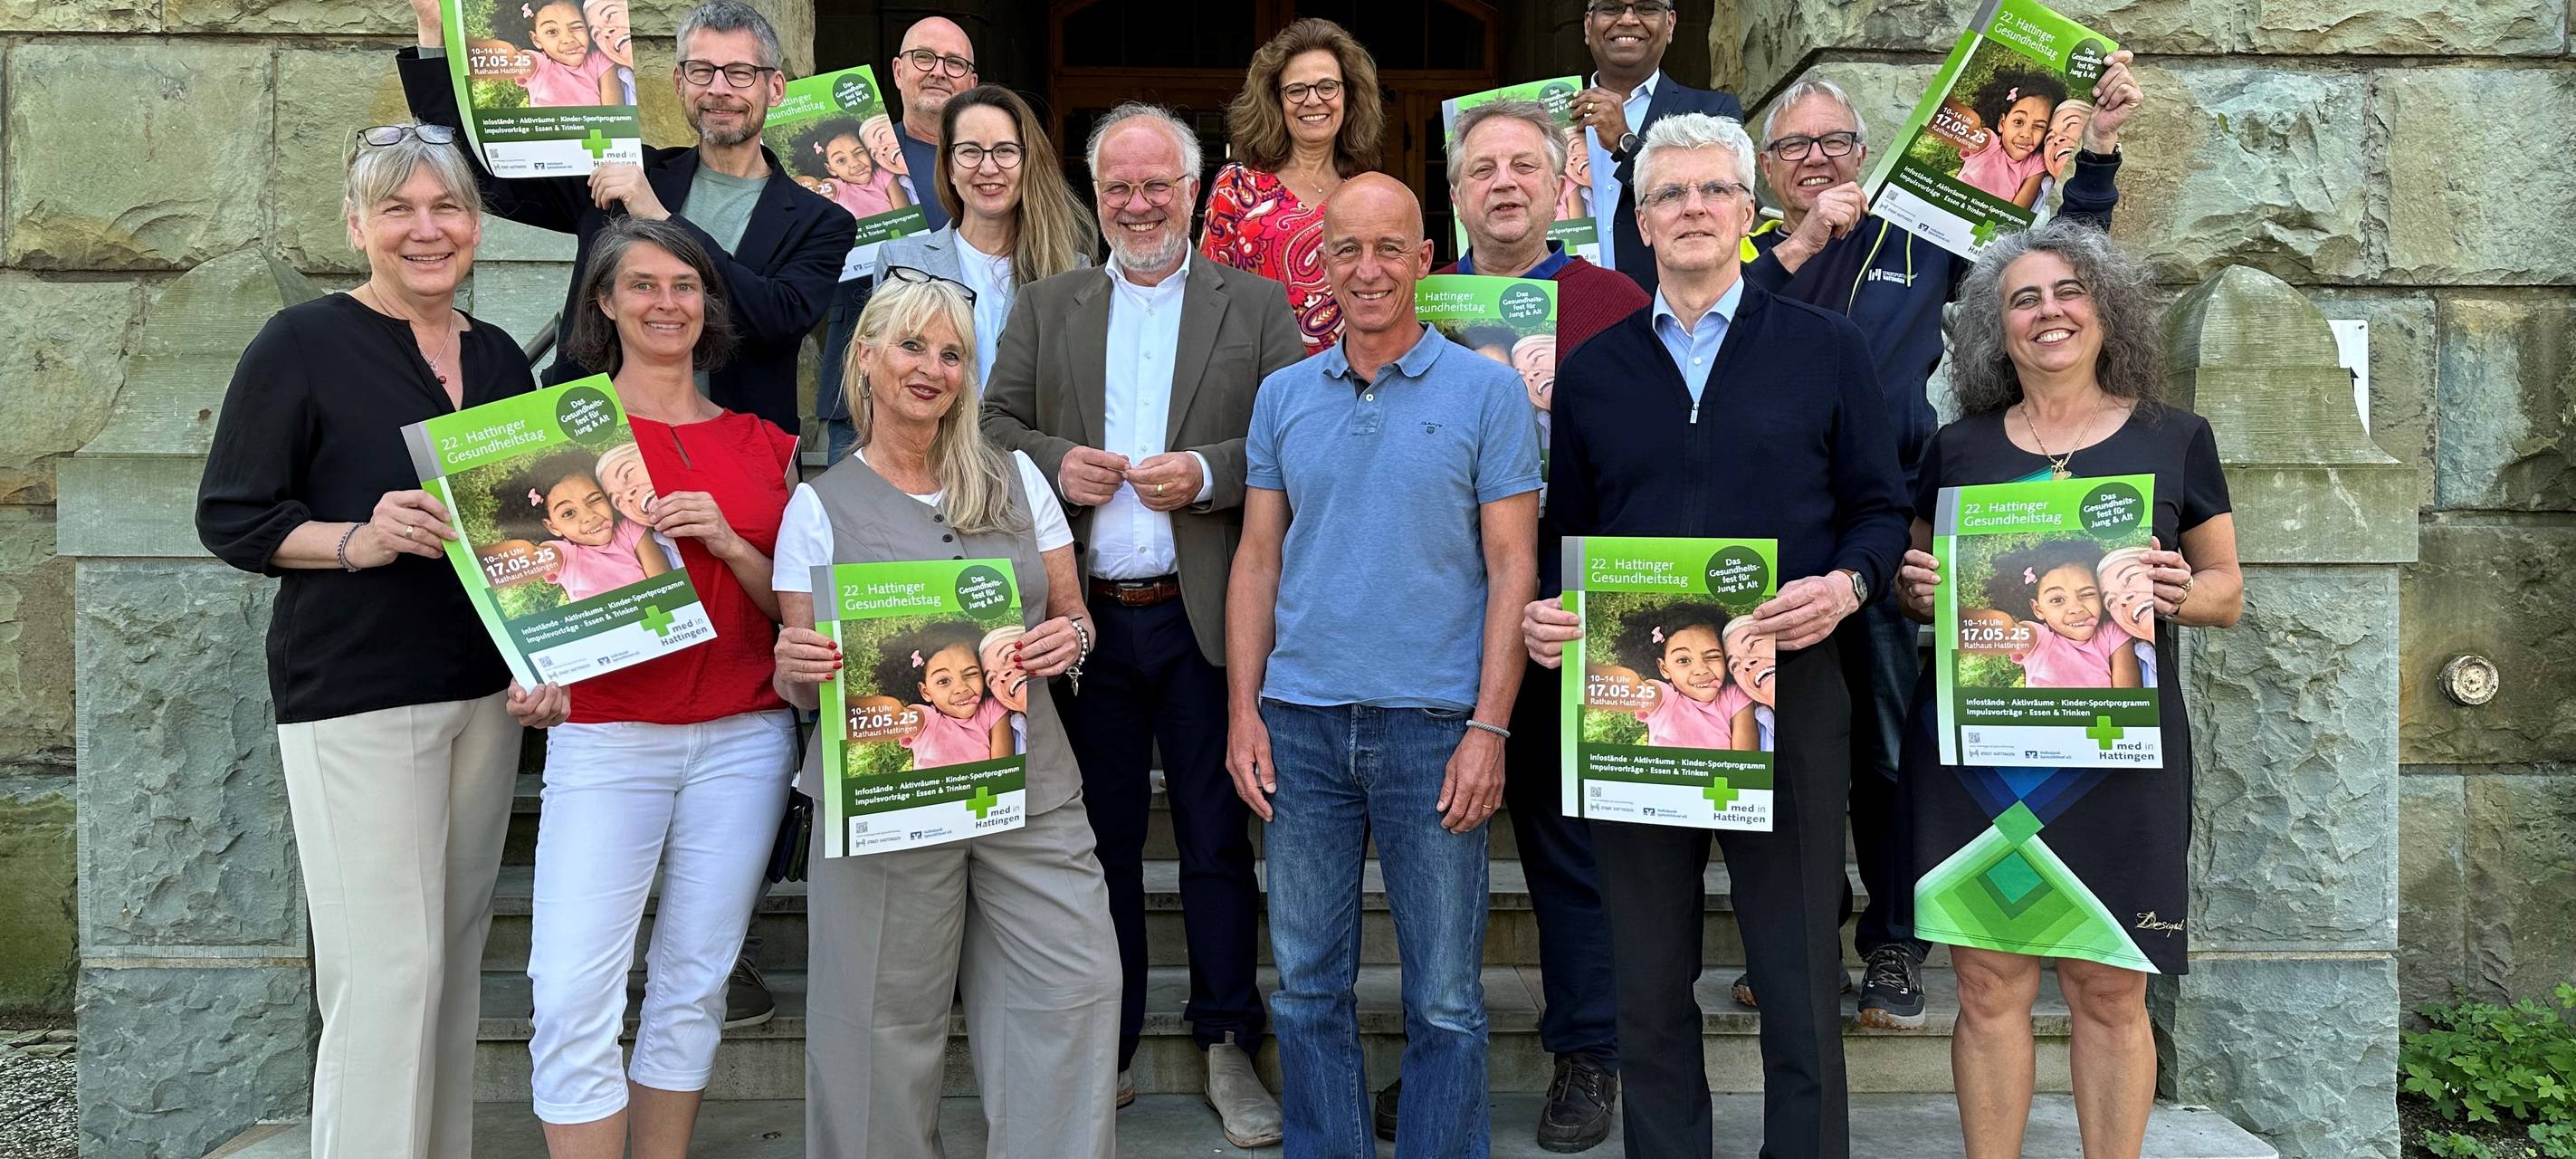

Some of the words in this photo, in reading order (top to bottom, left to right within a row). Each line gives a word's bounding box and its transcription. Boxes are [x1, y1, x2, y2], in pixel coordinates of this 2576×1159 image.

[1999, 10, 2014, 24] 22.
[2016, 17, 2056, 43] Hattinger
[1993, 22, 2059, 61] Gesundheitstag
[471, 55, 531, 68] 17.05.25
[766, 101, 825, 120] esundheitstag
[1961, 116, 1973, 125] Uhr
[1935, 113, 1988, 144] 17.05.25
[1931, 124, 1954, 139] Rathaus
[1953, 135, 1980, 150] Hattingen
[1899, 173, 1941, 197] Impulsvorträge
[1943, 195, 1960, 206] Essen
[1966, 205, 1986, 217] Trinken
[1903, 166, 1933, 184] Infostände
[1935, 183, 1968, 200] Aktivräume
[1970, 198, 2027, 225] Kinder-Sportprogramm
[1426, 292, 1474, 302] Hattinger
[1415, 302, 1485, 313] esundheitstag
[570, 398, 586, 408] Das
[560, 400, 605, 423] Gesundheits-
[575, 414, 589, 426] fest
[587, 410, 599, 419] für
[575, 424, 593, 436] Jung
[591, 420, 599, 428] &
[600, 414, 611, 425] Alt
[441, 436, 463, 451] 22.
[465, 419, 527, 444] Hattinger
[446, 429, 546, 465] Gesundheitstag
[2101, 493, 2116, 501] Das
[1965, 503, 1983, 513] 22.
[1989, 501, 2048, 512] Hattinger
[2084, 497, 2135, 512] Gesundheits-
[1964, 513, 2063, 526] Gesundheitstag
[2091, 519, 2111, 528] Jung
[2122, 512, 2134, 522] Alt
[2097, 509, 2113, 518] fest
[510, 548, 525, 556] Uhr
[485, 547, 557, 578] 17.05.25
[1591, 559, 1609, 569] 22.
[1615, 559, 1674, 572] Hattinger
[1725, 558, 1741, 566] Das
[494, 572, 523, 585] Rathaus
[523, 562, 559, 576] Hattingen
[1709, 564, 1760, 577] Gesundheits-
[971, 575, 986, 583] Das
[1592, 572, 1689, 587] Gesundheitstag
[1722, 574, 1738, 583] fest
[1747, 580, 1759, 589] Alt
[843, 585, 863, 597] 22.
[867, 582, 926, 595] Hattinger
[959, 580, 1003, 594] Gesundheits-
[969, 600, 987, 609] Jung
[995, 594, 1005, 603] Alt
[971, 590, 986, 600] fest
[520, 620, 559, 636] Infostände
[565, 607, 605, 623] Aktivräume
[608, 580, 684, 608] Kinder-Sportprogramm
[845, 595, 941, 610] Gesundheitstag
[526, 624, 579, 644] Impulsvorträge
[583, 618, 605, 627] Essen
[612, 606, 638, 618] Trinken
[672, 618, 693, 633] med
[660, 627, 707, 647] Hattingen
[1961, 627, 2030, 641] 17.05.25
[1994, 642, 2029, 650] Hattingen
[1588, 685, 1655, 698] 17.05.25
[1620, 699, 1655, 708] Hattingen
[2061, 699, 2150, 708] Kinder-Sportprogramm
[849, 710, 918, 730] 17.05.25
[1967, 709, 2022, 717] Impulsvorträge
[853, 730, 881, 738] Rathaus
[883, 726, 918, 734] Hattingen
[2117, 742, 2142, 750] med
[1589, 754, 1627, 762] Infostände
[1633, 757, 1674, 765] Aktivräume
[1682, 759, 1765, 770] Kinder-Sportprogramm
[2099, 752, 2154, 761] Hattingen
[1590, 764, 1644, 774] Impulsvorträge
[855, 785, 893, 796] Infostände
[899, 779, 940, 790] Aktivräume
[946, 766, 1020, 782] Kinder-Sportprogramm
[855, 793, 910, 806] Impulsvorträge
[946, 784, 970, 792] Trinken
[991, 805, 1010, 817] med
[1732, 804, 1754, 812] med
[976, 815, 1019, 829] Hattingen
[1714, 813, 1765, 824] Hattingen
